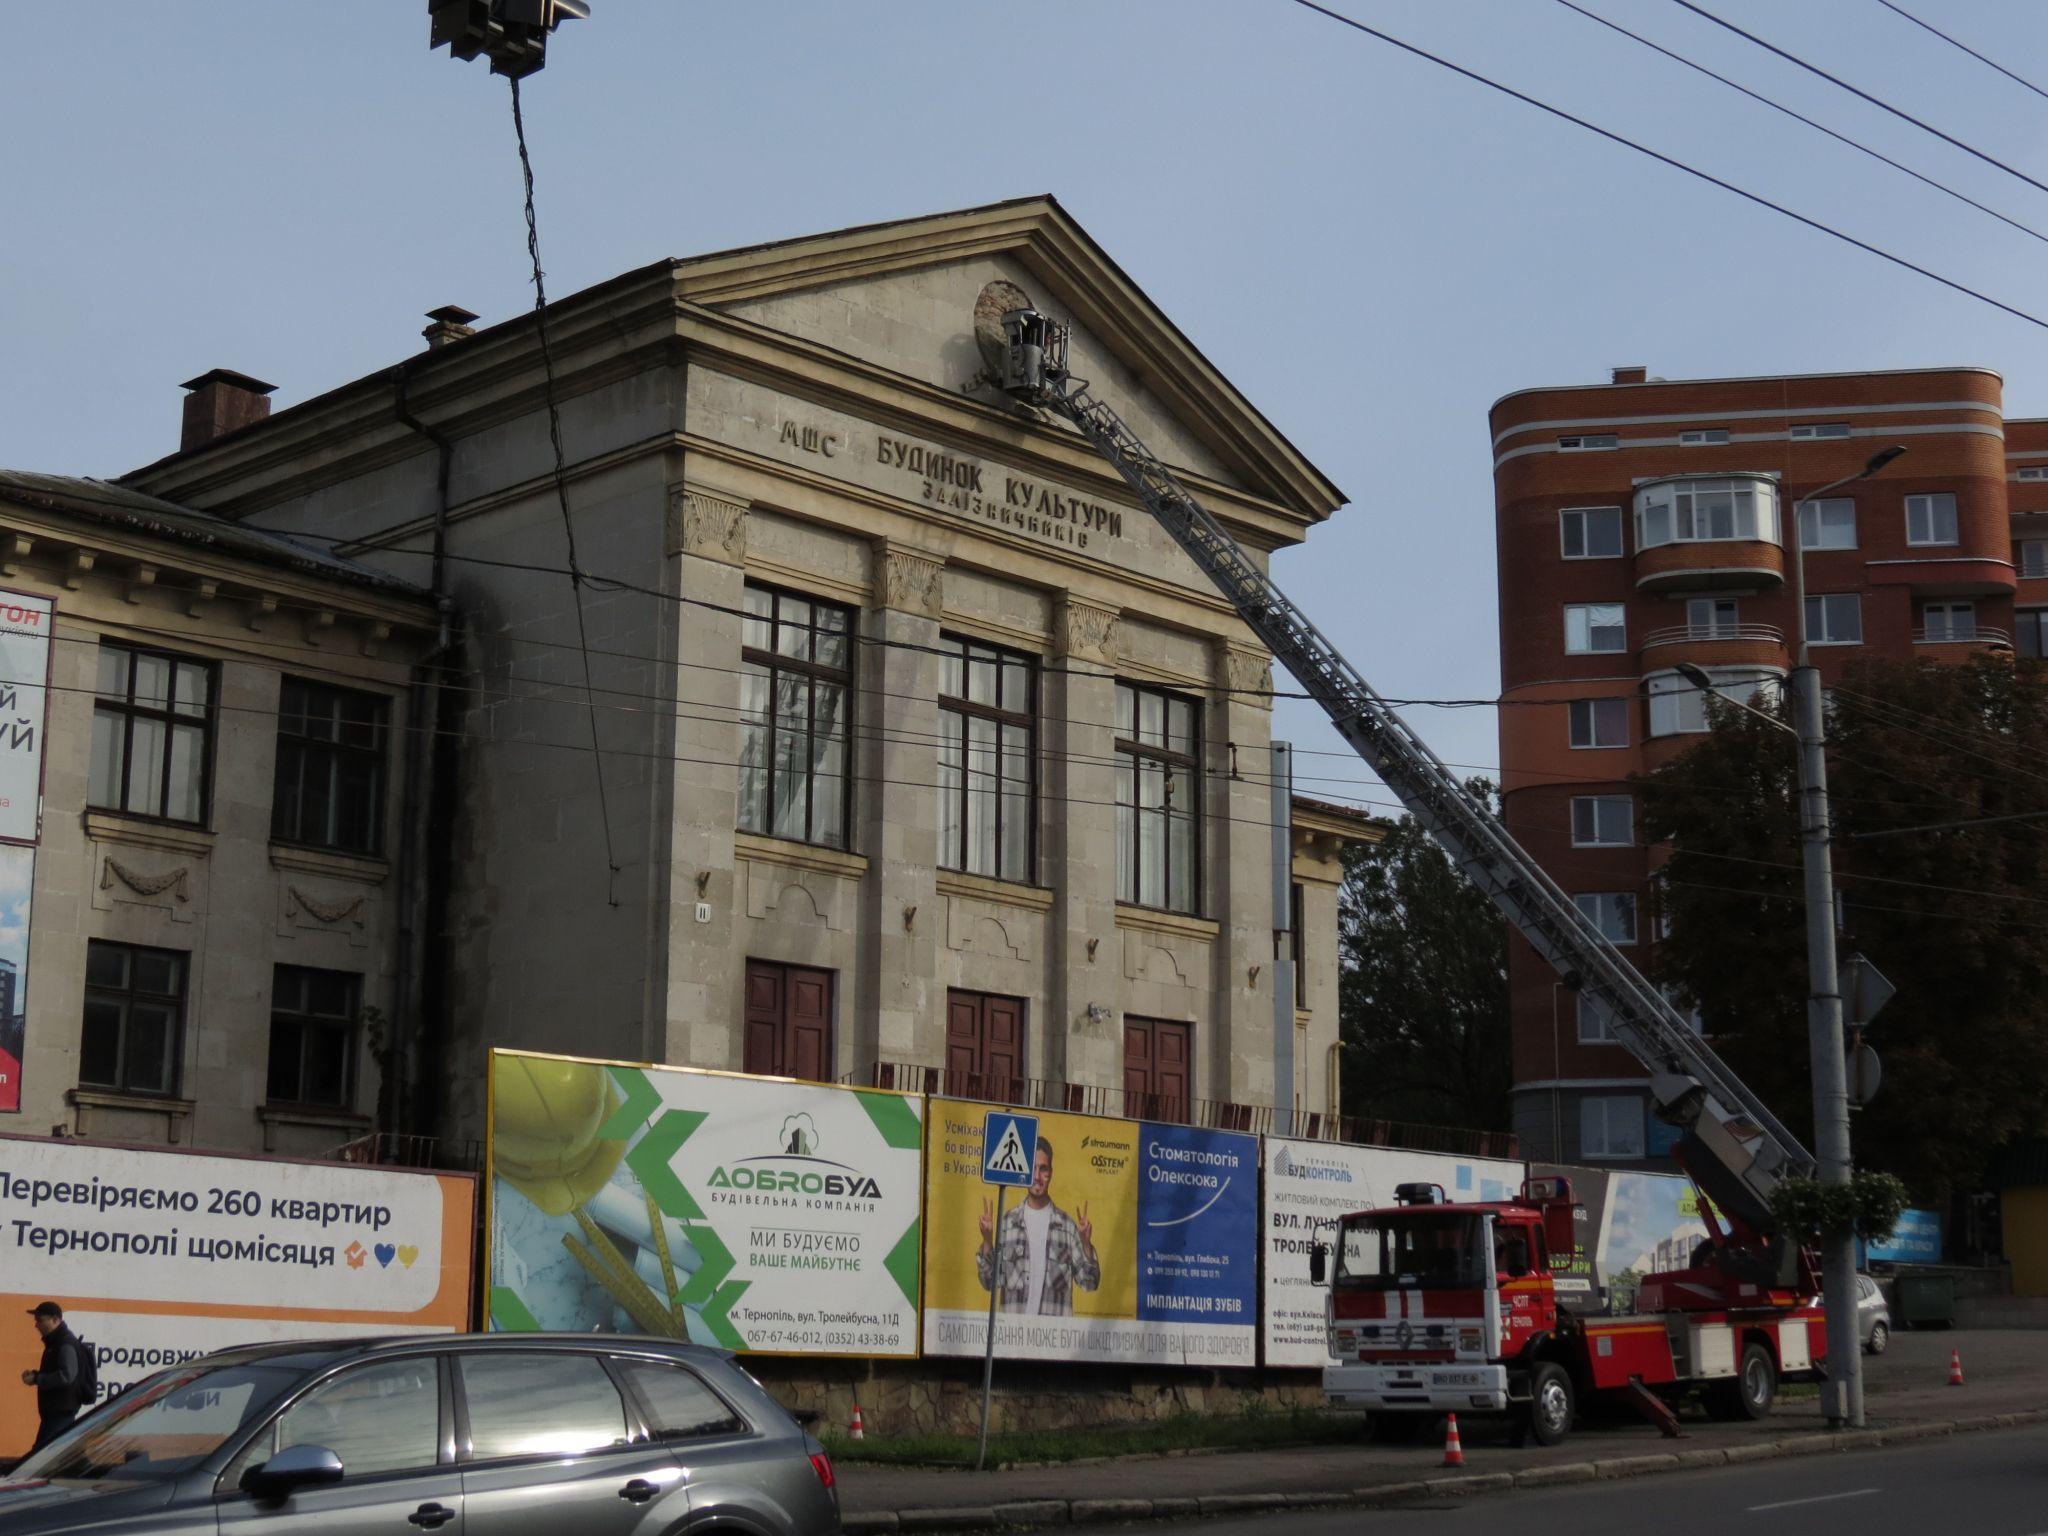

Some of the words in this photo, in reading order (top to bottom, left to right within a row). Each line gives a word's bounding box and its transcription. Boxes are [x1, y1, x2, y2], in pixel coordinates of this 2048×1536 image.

[876, 435, 984, 494] БУДИНОК
[1005, 477, 1123, 539] КУЛЬТУРИ
[922, 480, 1089, 549] ЗАЛІЗНИЧНИКІВ
[1149, 1141, 1239, 1168] Стоматологія
[1148, 1164, 1218, 1188] Олексюка
[1288, 1165, 1352, 1182] БУДКОНТРОЛЬ
[0, 1171, 199, 1213] Перевіряємо
[207, 1187, 262, 1218] 260
[271, 1198, 391, 1231] квартир
[711, 1192, 798, 1208] БУДІВЕЛЬНА
[806, 1199, 876, 1213] КОМПАНІЯ
[1274, 1192, 1318, 1207] ЖИТЛОВИЙ
[1319, 1197, 1359, 1210] КОМПЛЕКС
[1273, 1213, 1301, 1229] ВУЛ.
[12, 1219, 178, 1258] Тернополі
[188, 1233, 336, 1267] щомісяця
[750, 1231, 776, 1248] МИ
[783, 1233, 861, 1252] БУДУЄМО
[750, 1253, 787, 1268] ВАШЕ
[790, 1254, 861, 1271] МАЙБУТНЄ
[1147, 1294, 1212, 1313] ІМПЛАНТАЦІЯ
[1214, 1298, 1242, 1313] ЗУБІВ
[743, 1308, 796, 1323] Тернопіль,
[797, 1312, 816, 1324] вул.
[818, 1311, 881, 1326] Тролейбусна,
[747, 1330, 823, 1345] 067-67-46-012,
[825, 1331, 856, 1346] (0352)
[858, 1333, 900, 1346] 43-38-69
[1026, 1327, 1057, 1348] МОЖЕ
[1060, 1329, 1087, 1349] БУТИ
[1087, 1330, 1145, 1354] ШКІДЛИВИМ
[1147, 1332, 1167, 1353] ДЛЯ
[1169, 1333, 1205, 1354] ВАШОГО
